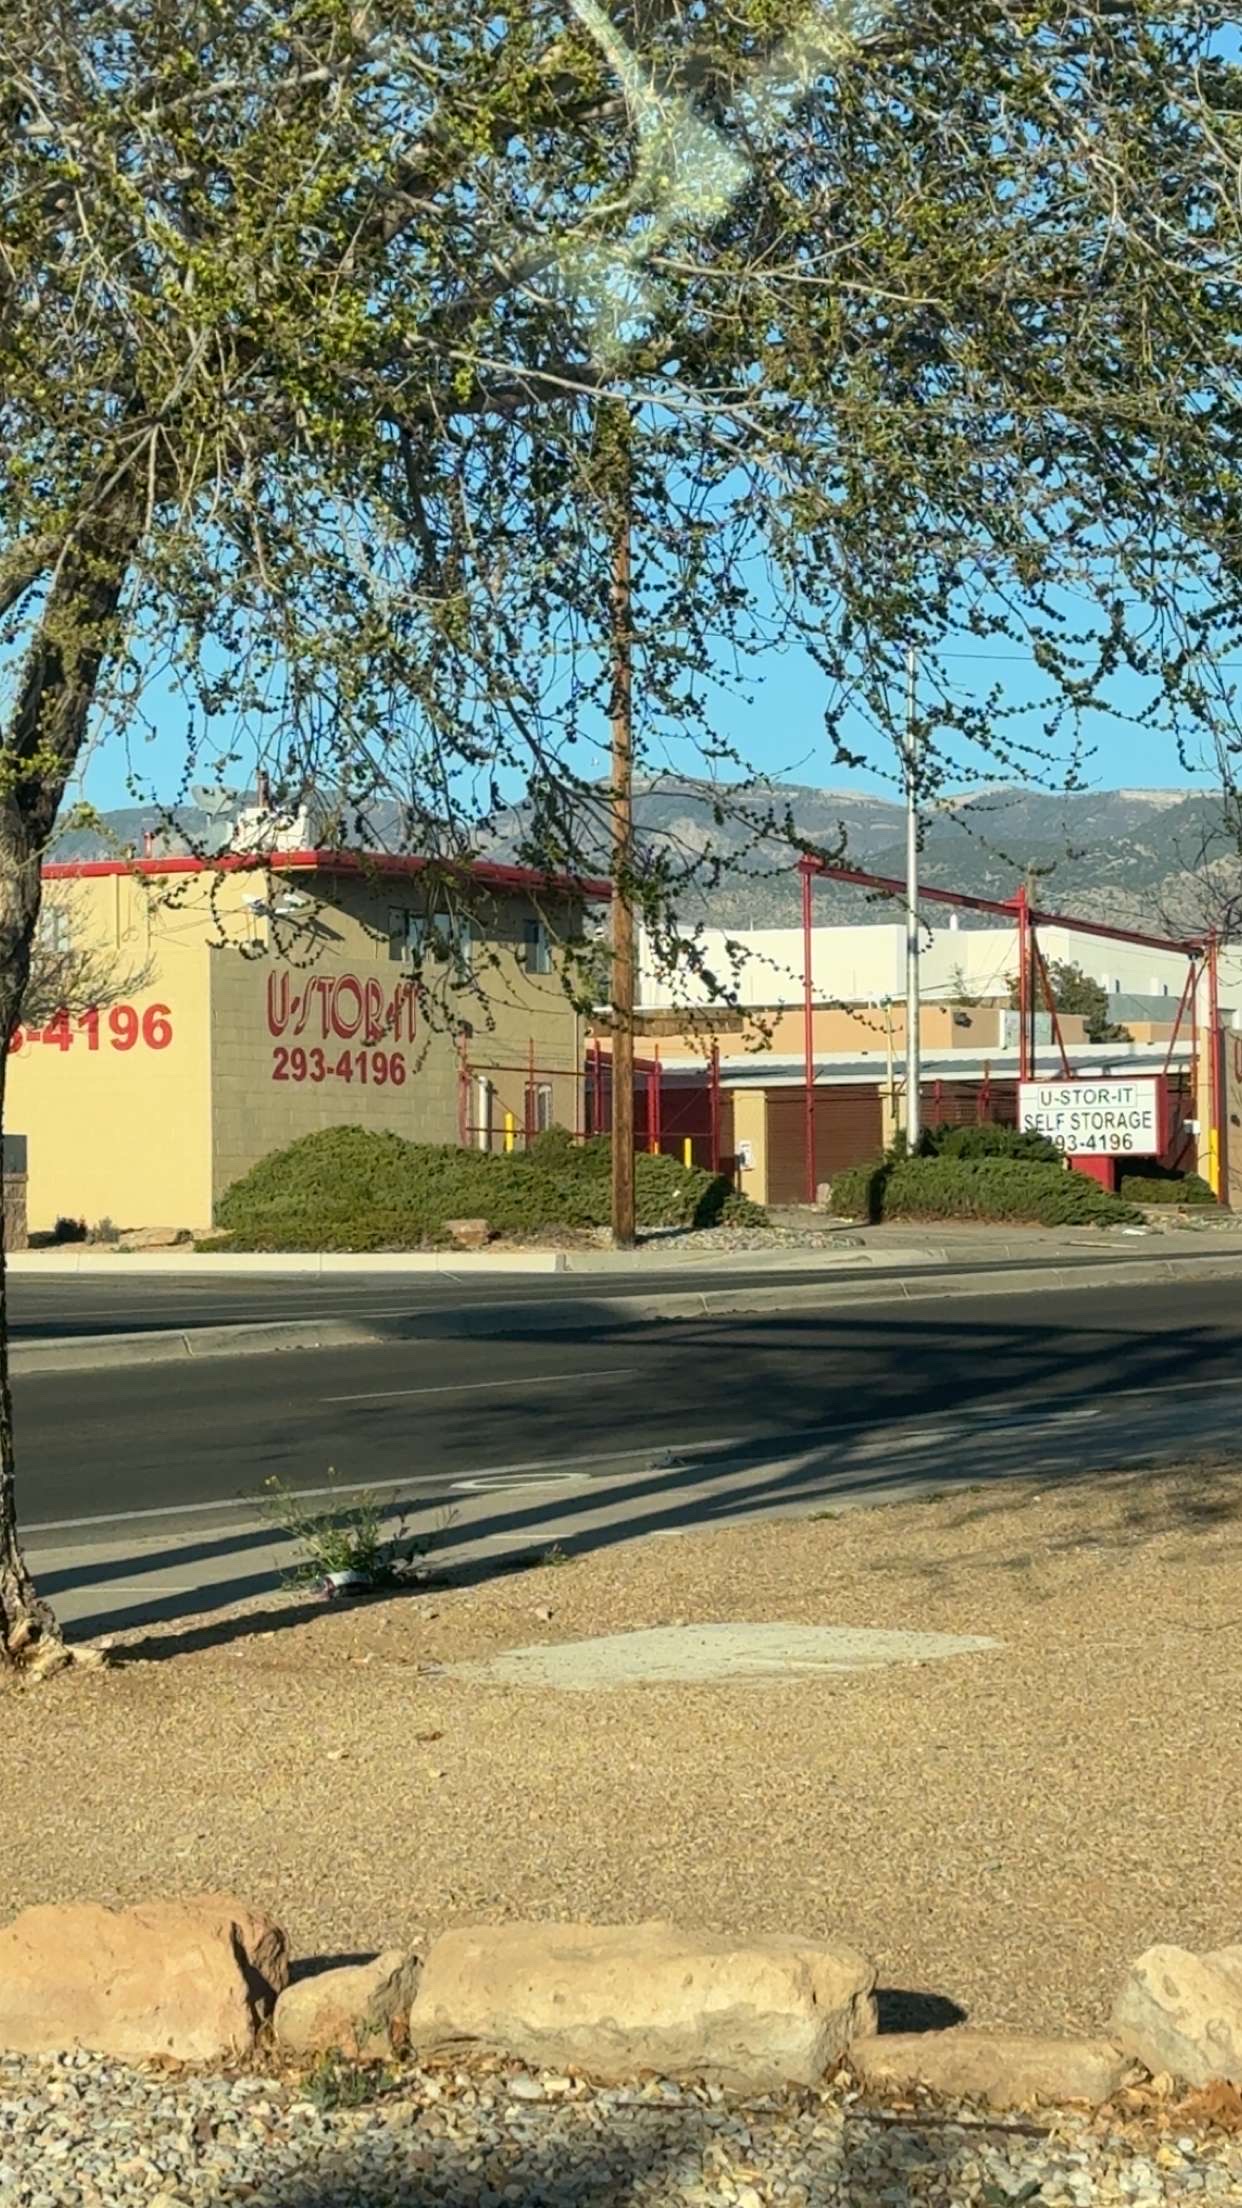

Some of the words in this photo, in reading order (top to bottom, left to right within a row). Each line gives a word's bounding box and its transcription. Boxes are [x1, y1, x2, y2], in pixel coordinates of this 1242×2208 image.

[267, 970, 416, 1044] U-STOR-IT
[272, 1047, 406, 1085] 293-4196
[1040, 1087, 1133, 1106] U-STOR-IT
[1024, 1113, 1065, 1131] SELF
[1070, 1110, 1152, 1130] STORAGE
[1046, 1133, 1133, 1151] 93-4196
